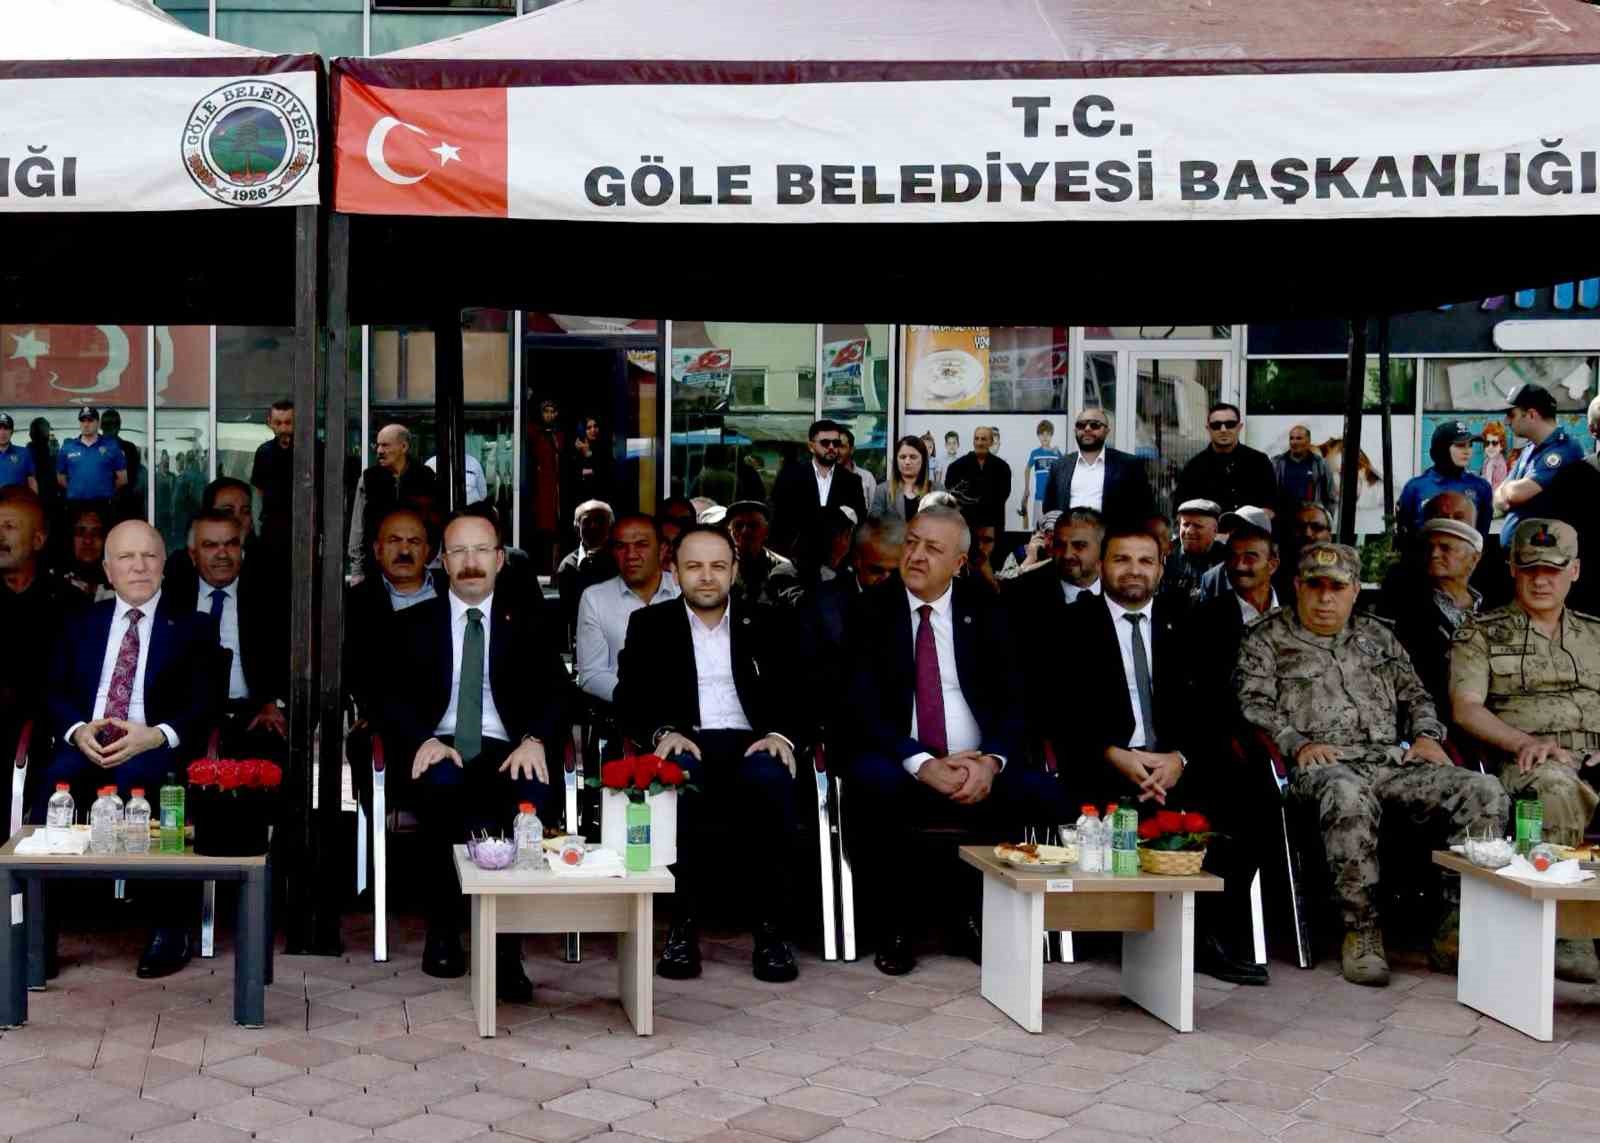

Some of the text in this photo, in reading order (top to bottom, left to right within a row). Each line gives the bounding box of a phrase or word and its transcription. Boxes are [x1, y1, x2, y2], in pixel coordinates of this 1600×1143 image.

[187, 100, 217, 145] GÖLE
[1012, 94, 1133, 138] T.C.
[583, 137, 1597, 207] GÖLE BELEDİYESİ BAŞKANLIĞI
